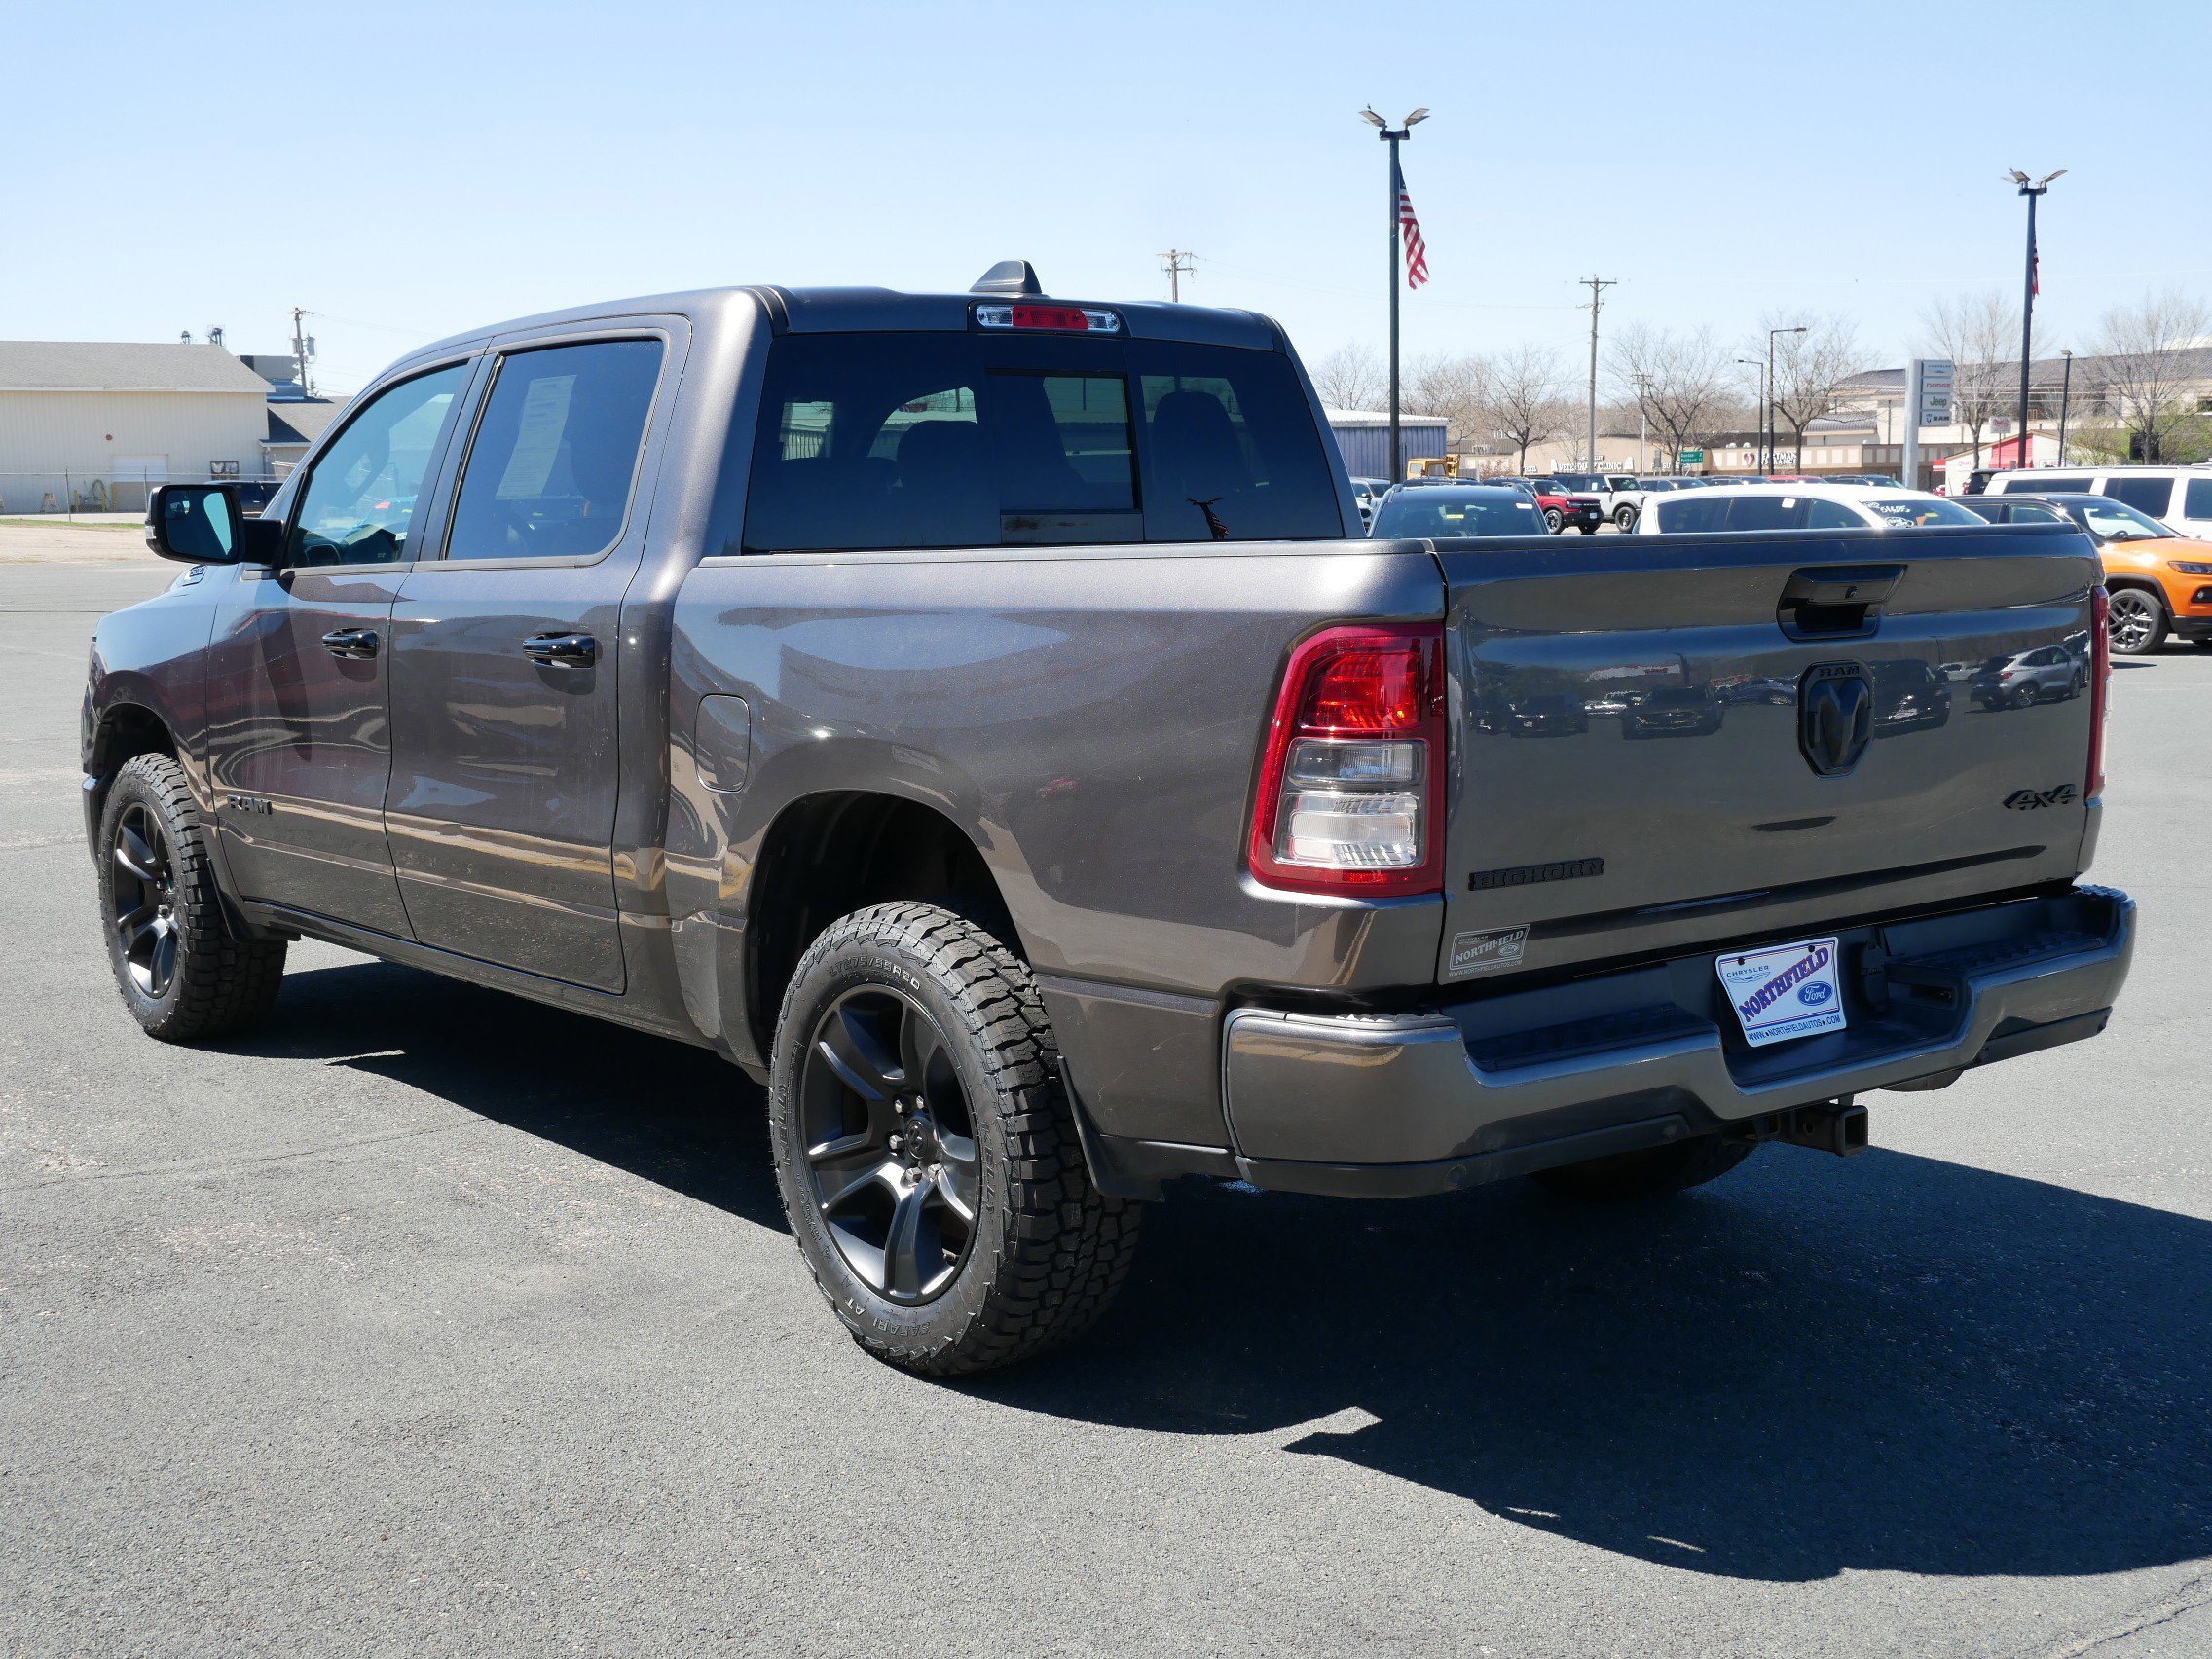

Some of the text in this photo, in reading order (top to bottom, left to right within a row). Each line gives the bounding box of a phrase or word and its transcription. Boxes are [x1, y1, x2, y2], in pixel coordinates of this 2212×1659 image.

[1930, 396, 1947, 407] Jeep
[1819, 665, 1860, 677] RAM
[227, 794, 273, 816] RAM
[1455, 930, 1524, 965] NORTHFIELD
[1726, 965, 1770, 978] CHRYSLER
[1739, 946, 1829, 1023] NORTHFIELD
[1804, 984, 1826, 1002] Ford
[872, 1316, 931, 1338] SAFARI
